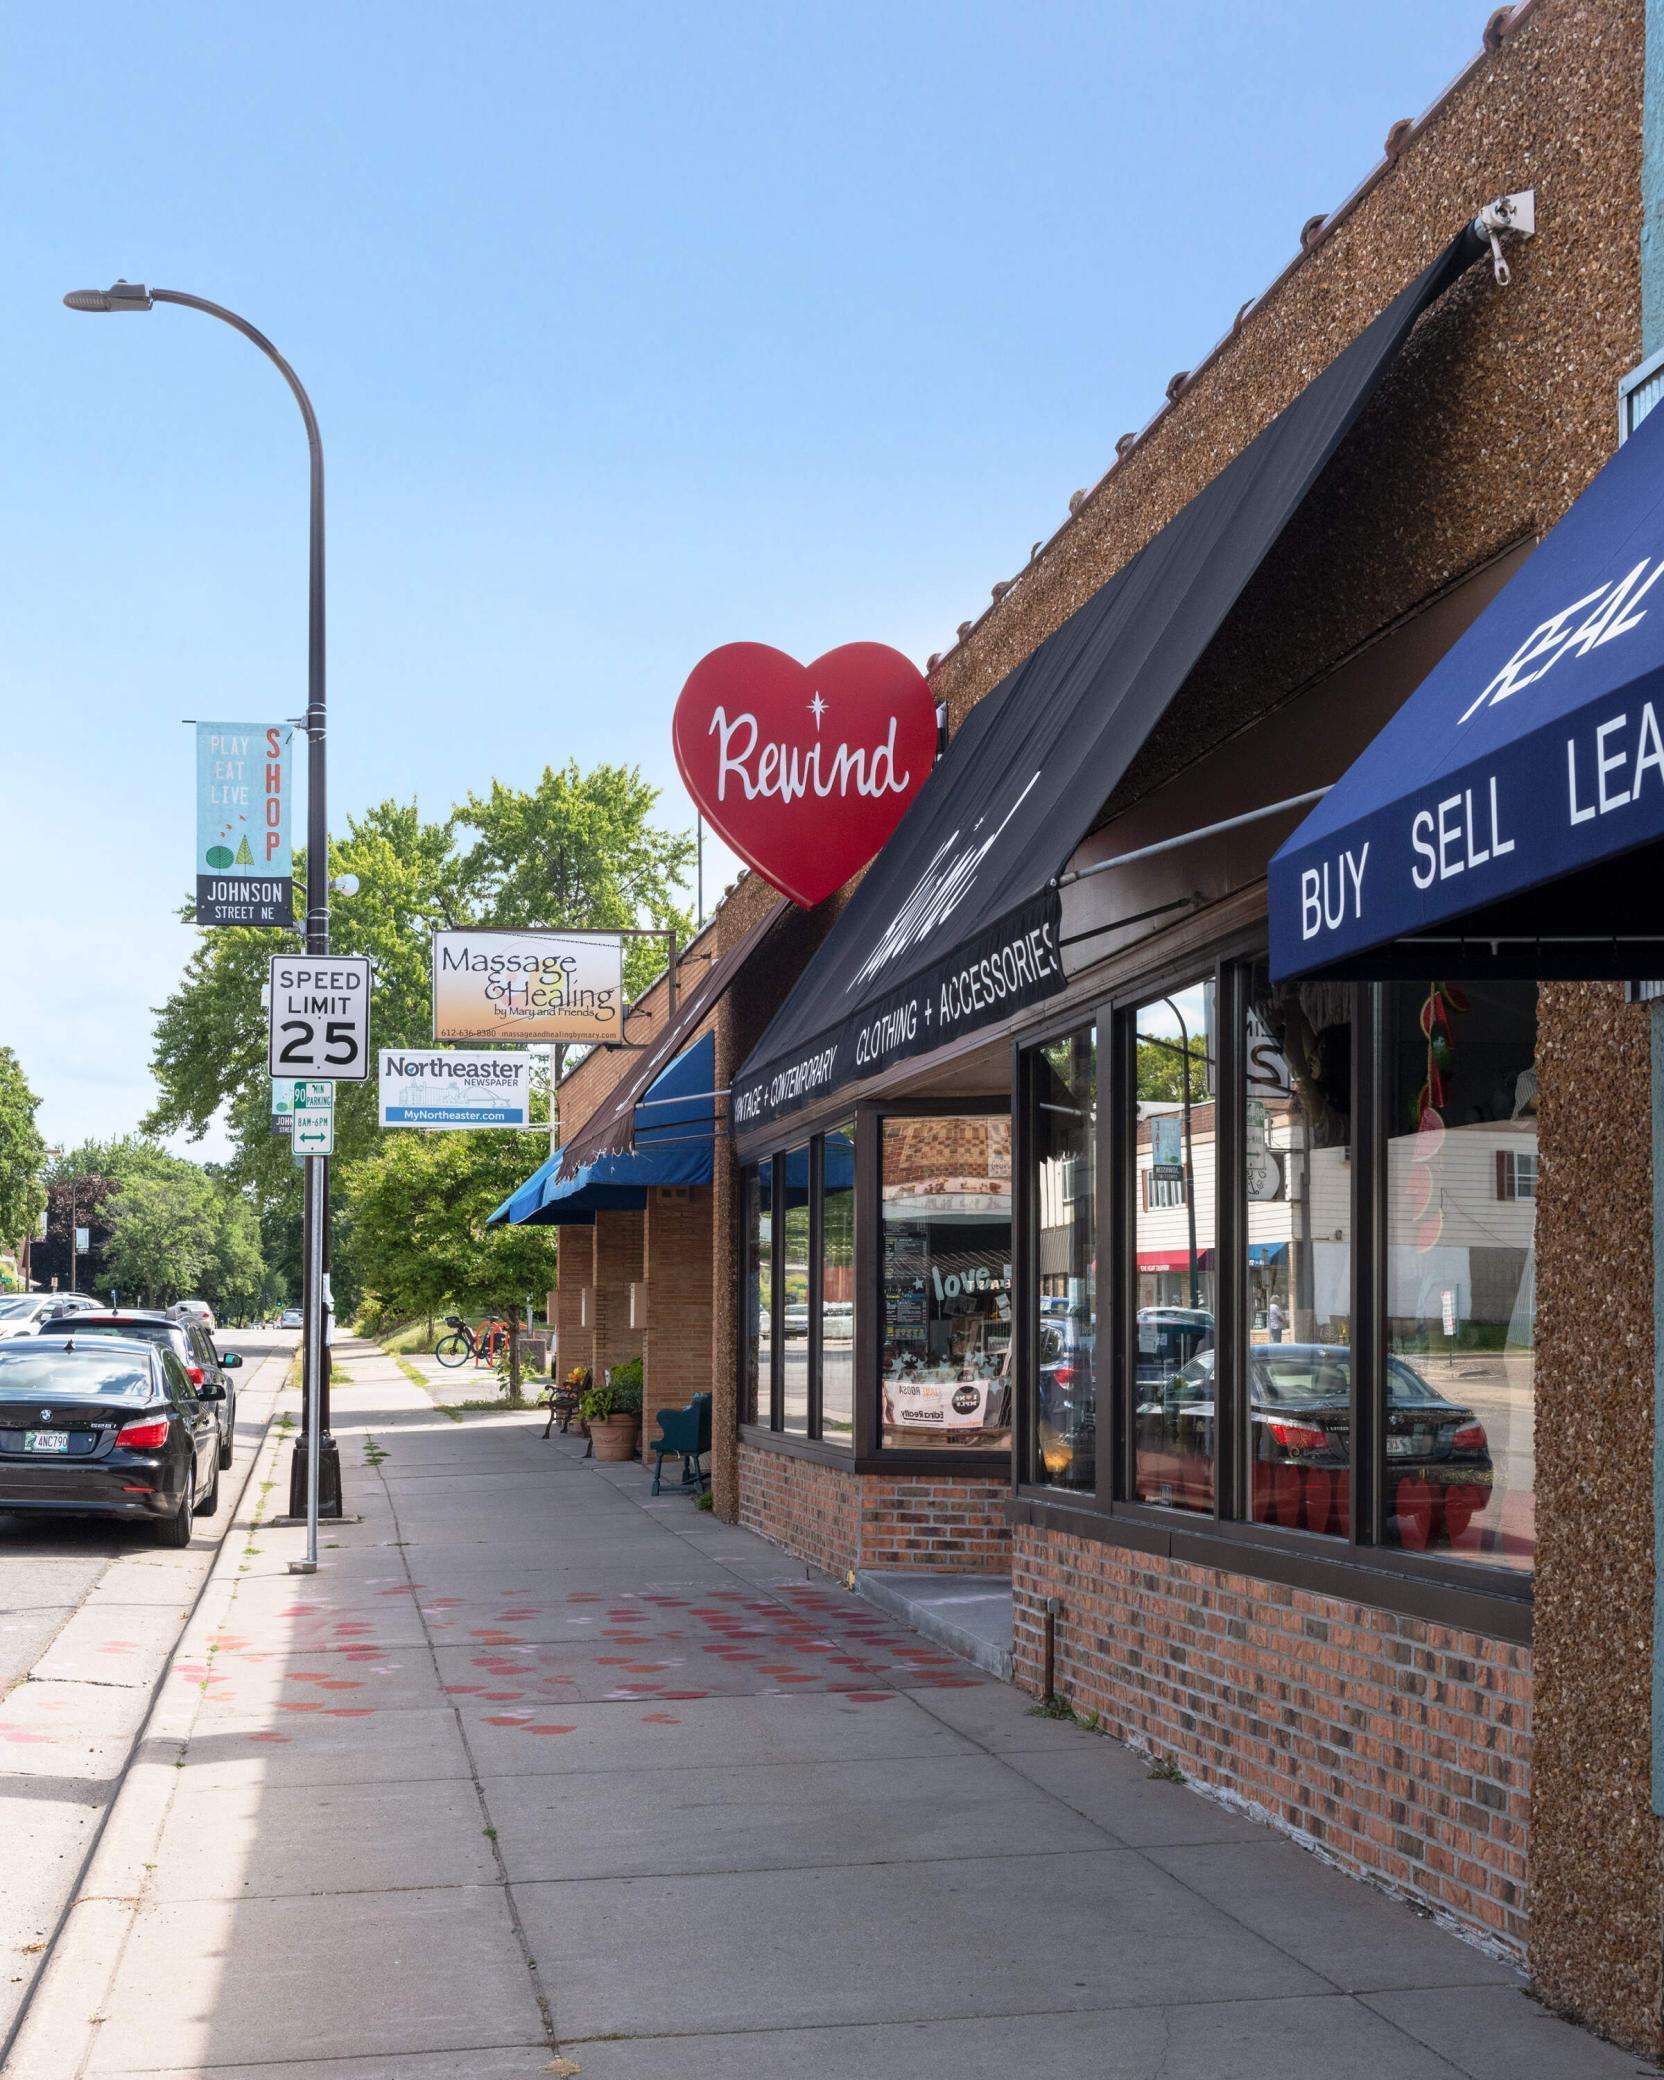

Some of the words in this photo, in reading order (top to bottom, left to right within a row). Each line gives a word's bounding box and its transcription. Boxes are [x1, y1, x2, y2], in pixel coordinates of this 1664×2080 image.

[210, 735, 249, 756] PLAY
[707, 694, 910, 804] Rewind
[215, 761, 245, 781] EAT
[210, 787, 249, 806] LIVE
[265, 727, 281, 862] SHOP
[1301, 841, 1370, 941] BUY
[1411, 775, 1516, 890] SELL
[1567, 701, 1664, 827] LEA
[207, 881, 283, 903] JOHNSON
[215, 905, 255, 920] STREET
[261, 906, 275, 920] NE
[442, 946, 578, 986] Massage
[279, 970, 361, 990] SPEED
[288, 995, 352, 1015] LIMIT
[494, 1004, 507, 1019] by
[509, 1007, 535, 1020] Mary
[535, 1005, 556, 1016] and
[558, 1006, 594, 1018] Friends
[770, 1044, 838, 1108] CONTEMPORARY
[856, 999, 917, 1066] CLOTHING
[939, 922, 1058, 1027] ACCESSORIES
[279, 1020, 359, 1065] 25
[501, 1031, 617, 1040] massageandhealingbymary.com
[385, 1056, 524, 1079] Northeaster
[313, 1084, 325, 1094] MIN
[464, 1078, 519, 1087] NEWSPAPER
[294, 1088, 306, 1103] 90
[306, 1096, 331, 1106] PARKING
[297, 1117, 329, 1127] 8AM-6PM
[404, 1109, 505, 1122] MyNortheaster.com
[931, 1264, 991, 1301] love
